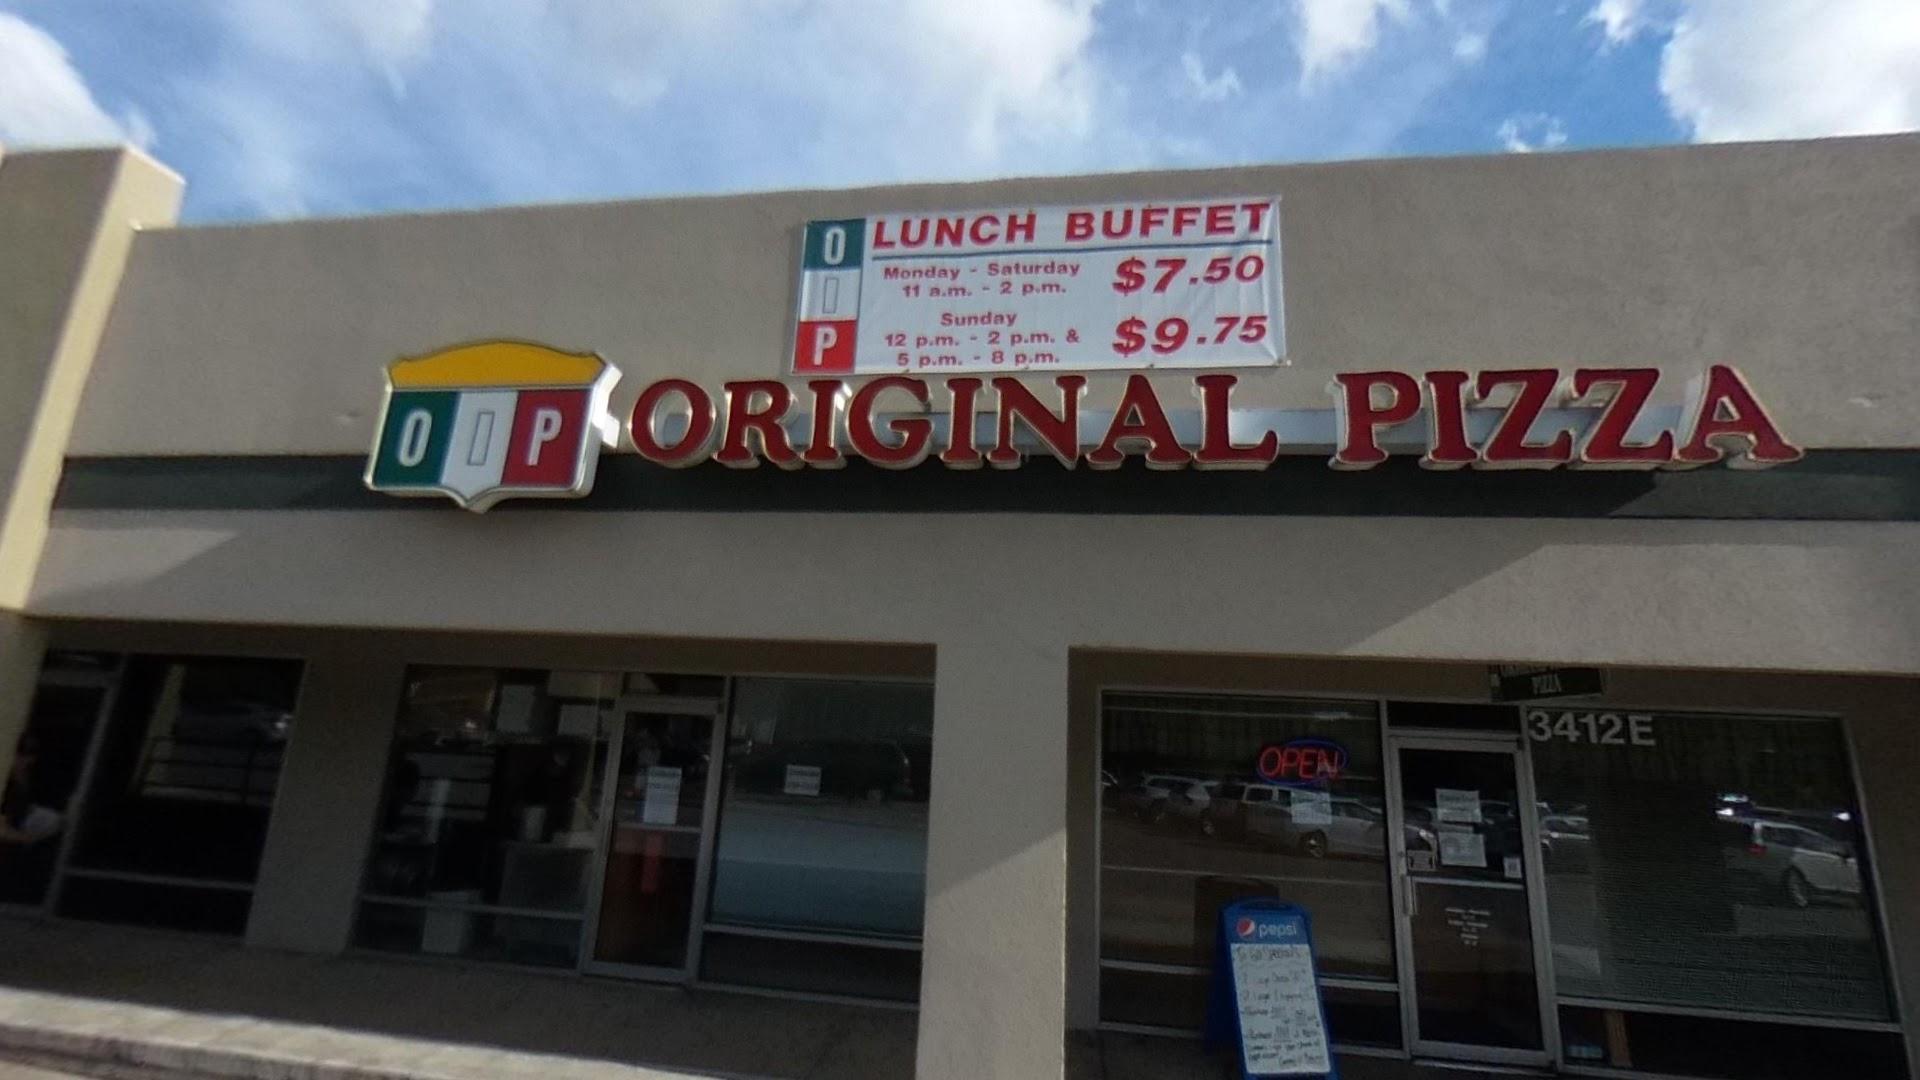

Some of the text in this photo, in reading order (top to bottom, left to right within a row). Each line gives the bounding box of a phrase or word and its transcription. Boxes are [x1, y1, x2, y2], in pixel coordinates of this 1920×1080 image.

[873, 203, 1271, 250] LUNCH BUFFET
[883, 265, 961, 281] Monday
[987, 261, 1081, 277] Saturday
[1112, 256, 1265, 296] $7.50
[902, 284, 921, 298] 11
[929, 287, 973, 298] a.m.
[999, 281, 1013, 295] 2
[1022, 282, 1067, 297] p.m.
[940, 311, 1018, 327] Sunday
[884, 333, 907, 347] 12
[916, 334, 960, 348] p.m.
[987, 330, 1001, 345] 2
[1010, 331, 1056, 345] p.m.
[1065, 328, 1081, 343] &
[1112, 315, 1268, 357] $9.75
[897, 352, 910, 367] 5
[918, 352, 963, 368] p.m.
[991, 350, 1005, 364] 8
[1014, 350, 1061, 365] p.m.
[625, 363, 1804, 471] ORIGINAL PIZZA
[1528, 710, 1657, 746] 3412E
[1259, 745, 1339, 779] OPEN
[1258, 922, 1297, 938] pepsi
